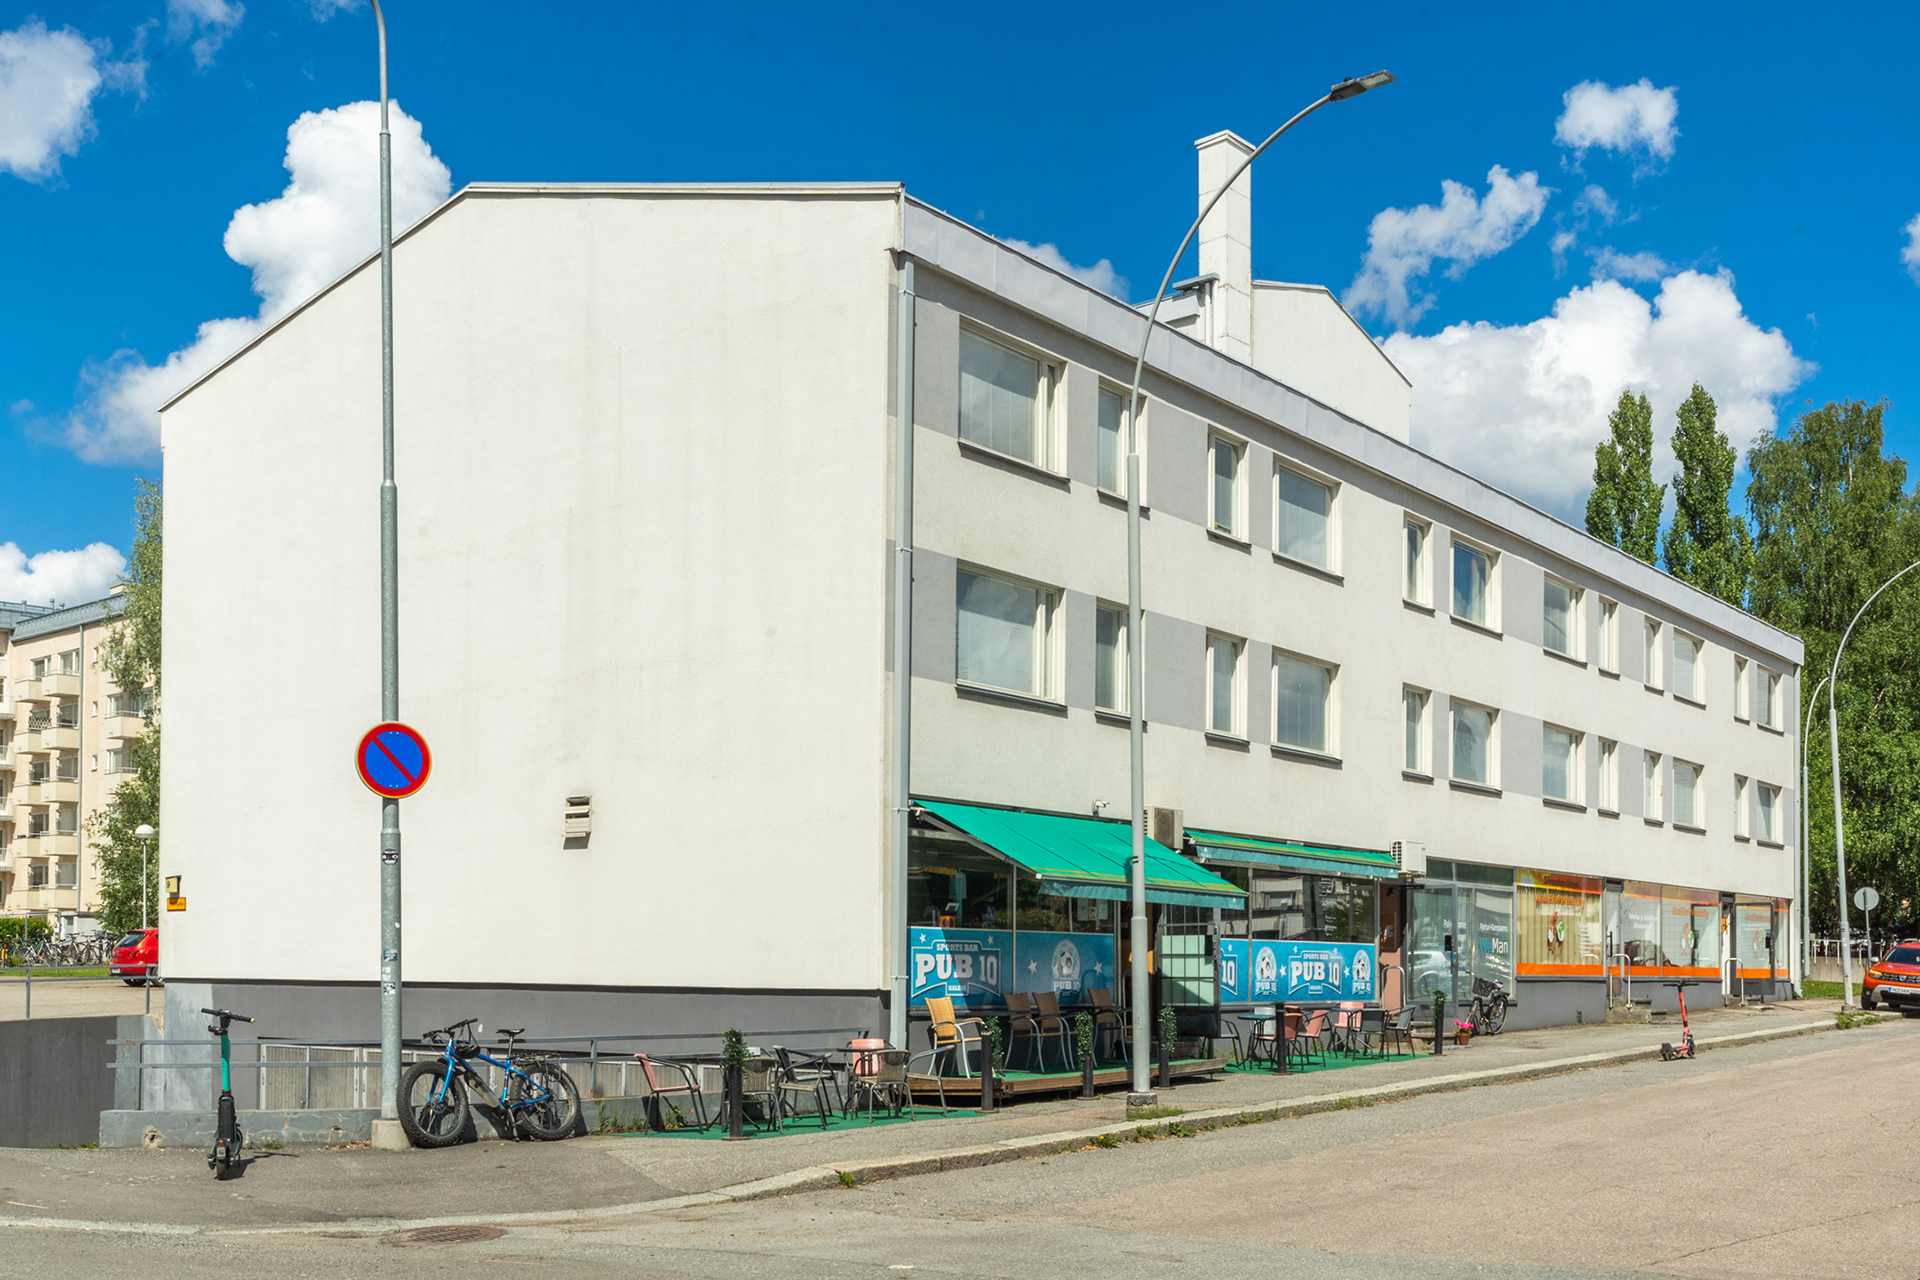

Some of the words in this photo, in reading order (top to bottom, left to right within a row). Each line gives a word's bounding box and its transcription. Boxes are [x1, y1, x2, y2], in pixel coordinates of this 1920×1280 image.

[936, 943, 963, 952] SPORTS
[964, 944, 978, 952] BAR
[1480, 937, 1508, 953] WoMan
[915, 953, 974, 988] PUB
[979, 955, 998, 986] 10
[1222, 960, 1236, 987] 10
[1291, 961, 1325, 988] PUB
[1328, 962, 1340, 987] 10
[1053, 981, 1072, 992] PUB
[1255, 982, 1270, 992] PUB
[1353, 982, 1365, 992] PUB
